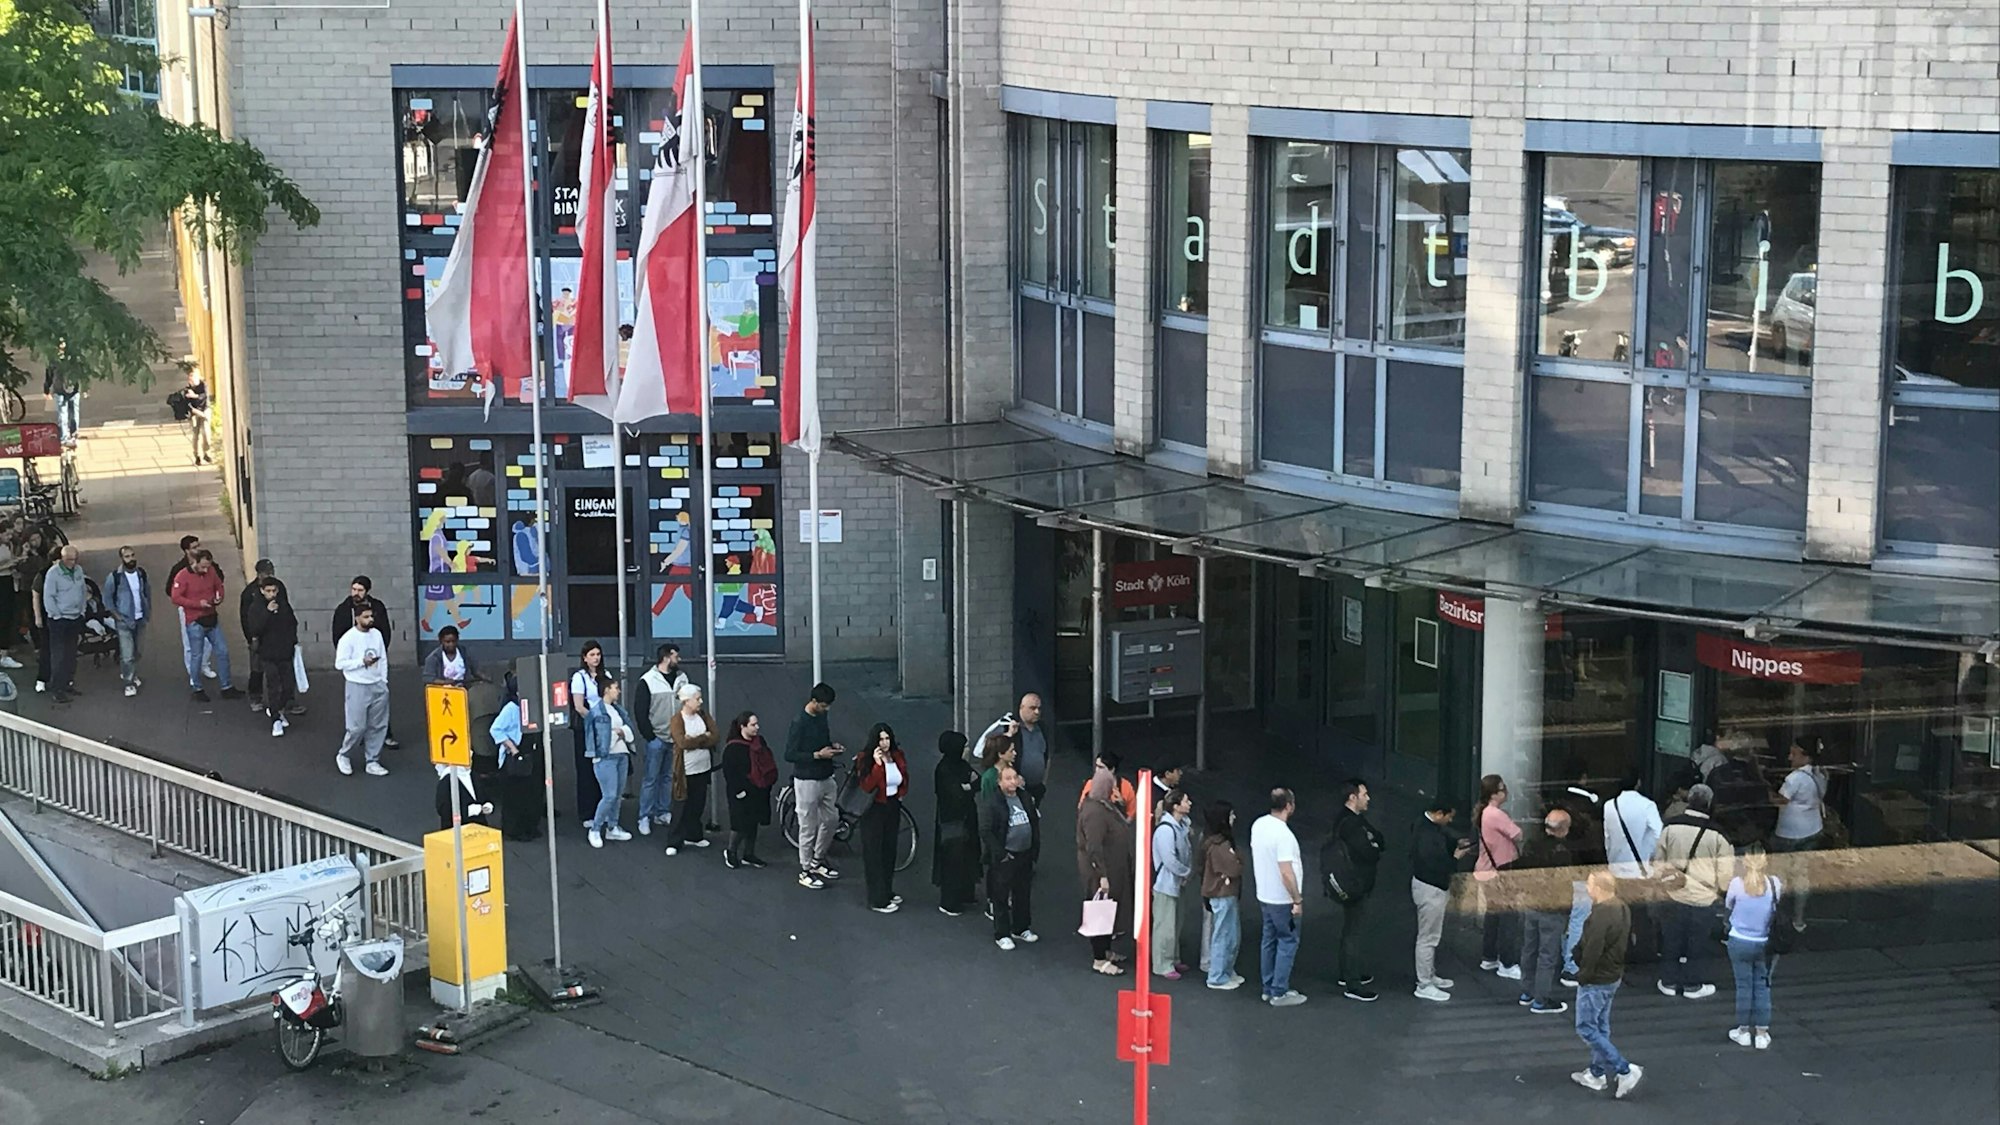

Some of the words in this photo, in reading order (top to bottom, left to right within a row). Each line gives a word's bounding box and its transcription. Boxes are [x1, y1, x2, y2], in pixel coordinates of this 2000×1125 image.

[554, 187, 578, 199] STA
[574, 498, 616, 510] EINGAN
[1115, 578, 1145, 592] Stadt
[1166, 574, 1190, 587] Köln
[1440, 593, 1484, 625] Bezirksr
[1732, 648, 1803, 676] Nippes
